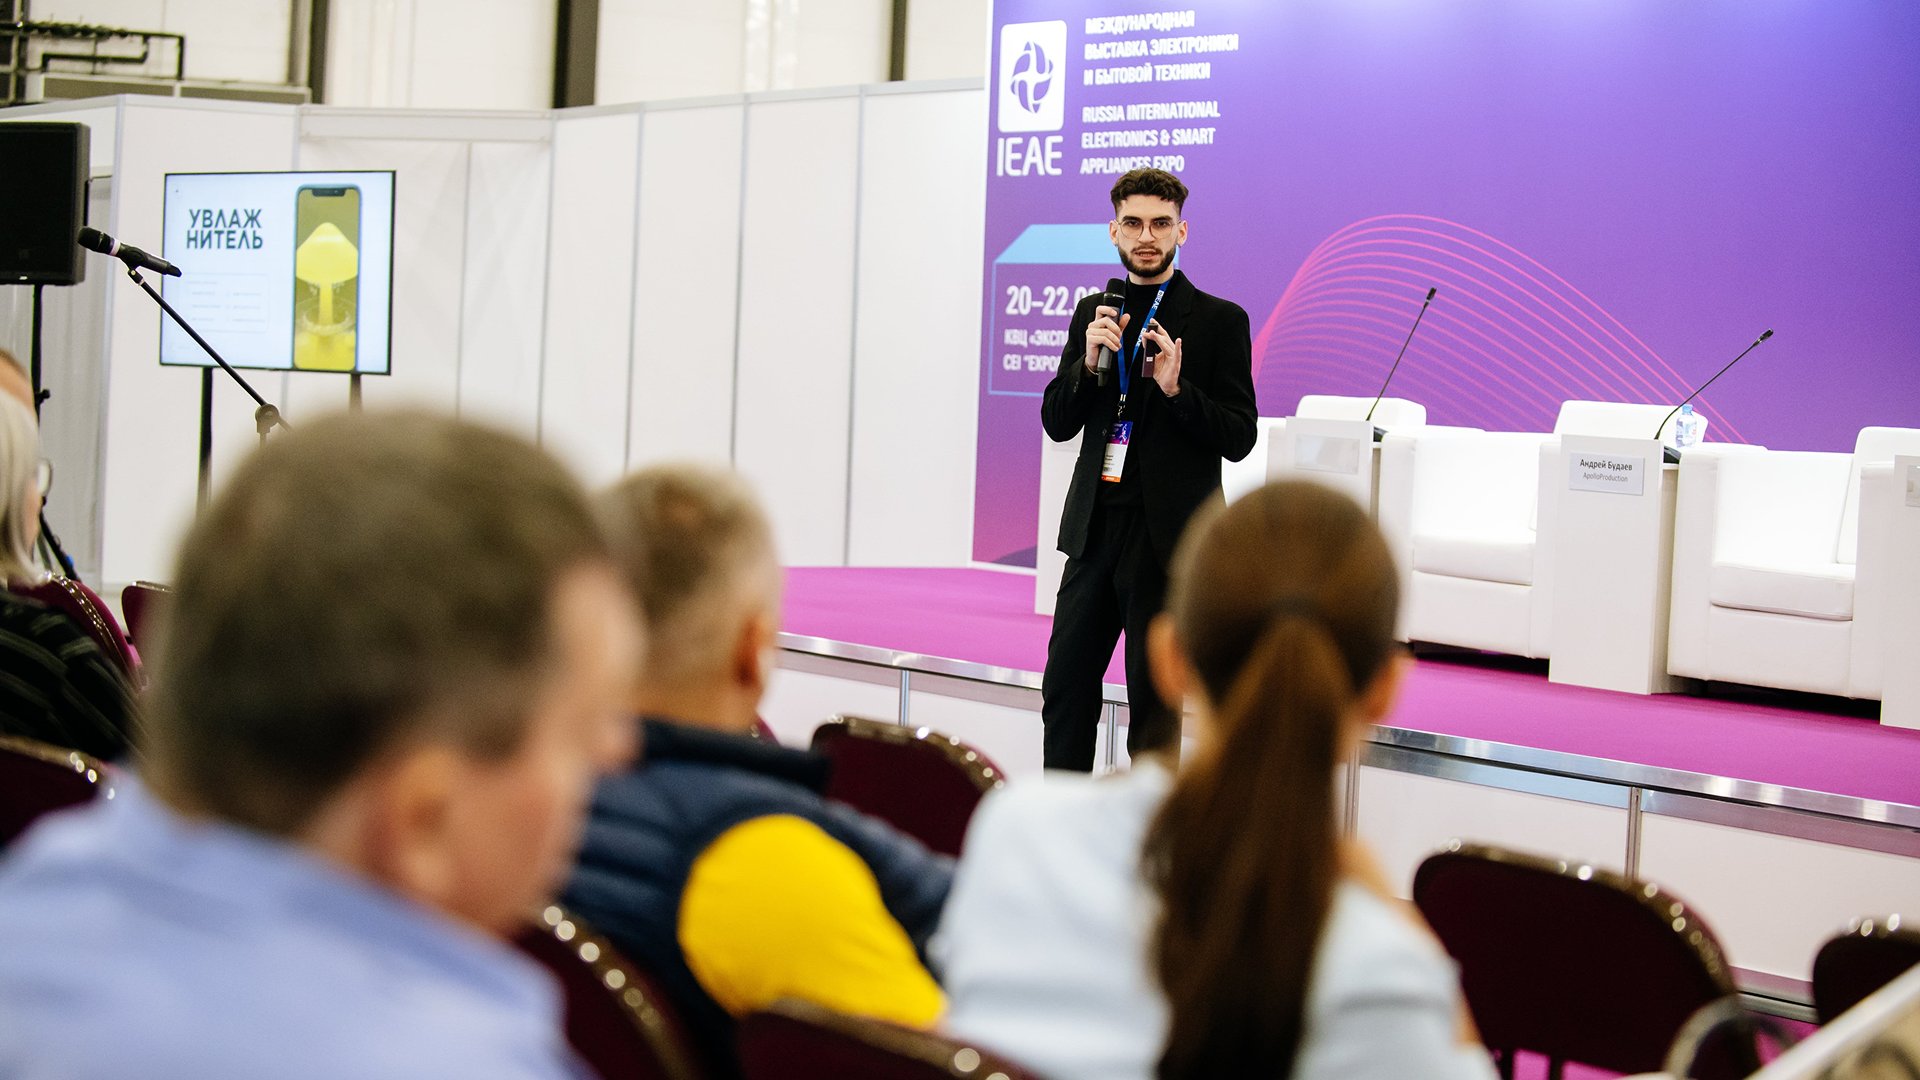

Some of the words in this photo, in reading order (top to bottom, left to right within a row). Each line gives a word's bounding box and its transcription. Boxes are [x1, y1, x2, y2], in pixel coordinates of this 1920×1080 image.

[1085, 11, 1195, 35] МЕЖДУНАРОДНАЯ
[1084, 40, 1148, 60] ВЫСТАВКА
[1150, 34, 1239, 55] ЭЛЕКТРОНИКИ
[1083, 69, 1094, 85] И
[1095, 63, 1152, 85] БЫТОВОЙ
[1154, 63, 1211, 81] ТЕХНИКИ
[1082, 106, 1125, 123] RUSSIA
[1126, 101, 1220, 121] INTERNATIONAL
[1081, 130, 1158, 148] ELECTRONICS
[1160, 129, 1170, 145] &
[1172, 128, 1216, 145] SMART
[997, 135, 1063, 177] IEAE
[188, 208, 263, 229] УВЛАЖ
[186, 230, 263, 250] НИТЕЛЬ
[1004, 328, 1028, 348] КВЦ
[1580, 458, 1606, 470] Андрей
[1607, 461, 1633, 472] Будаев
[1583, 472, 1628, 482] ApolloProduction
